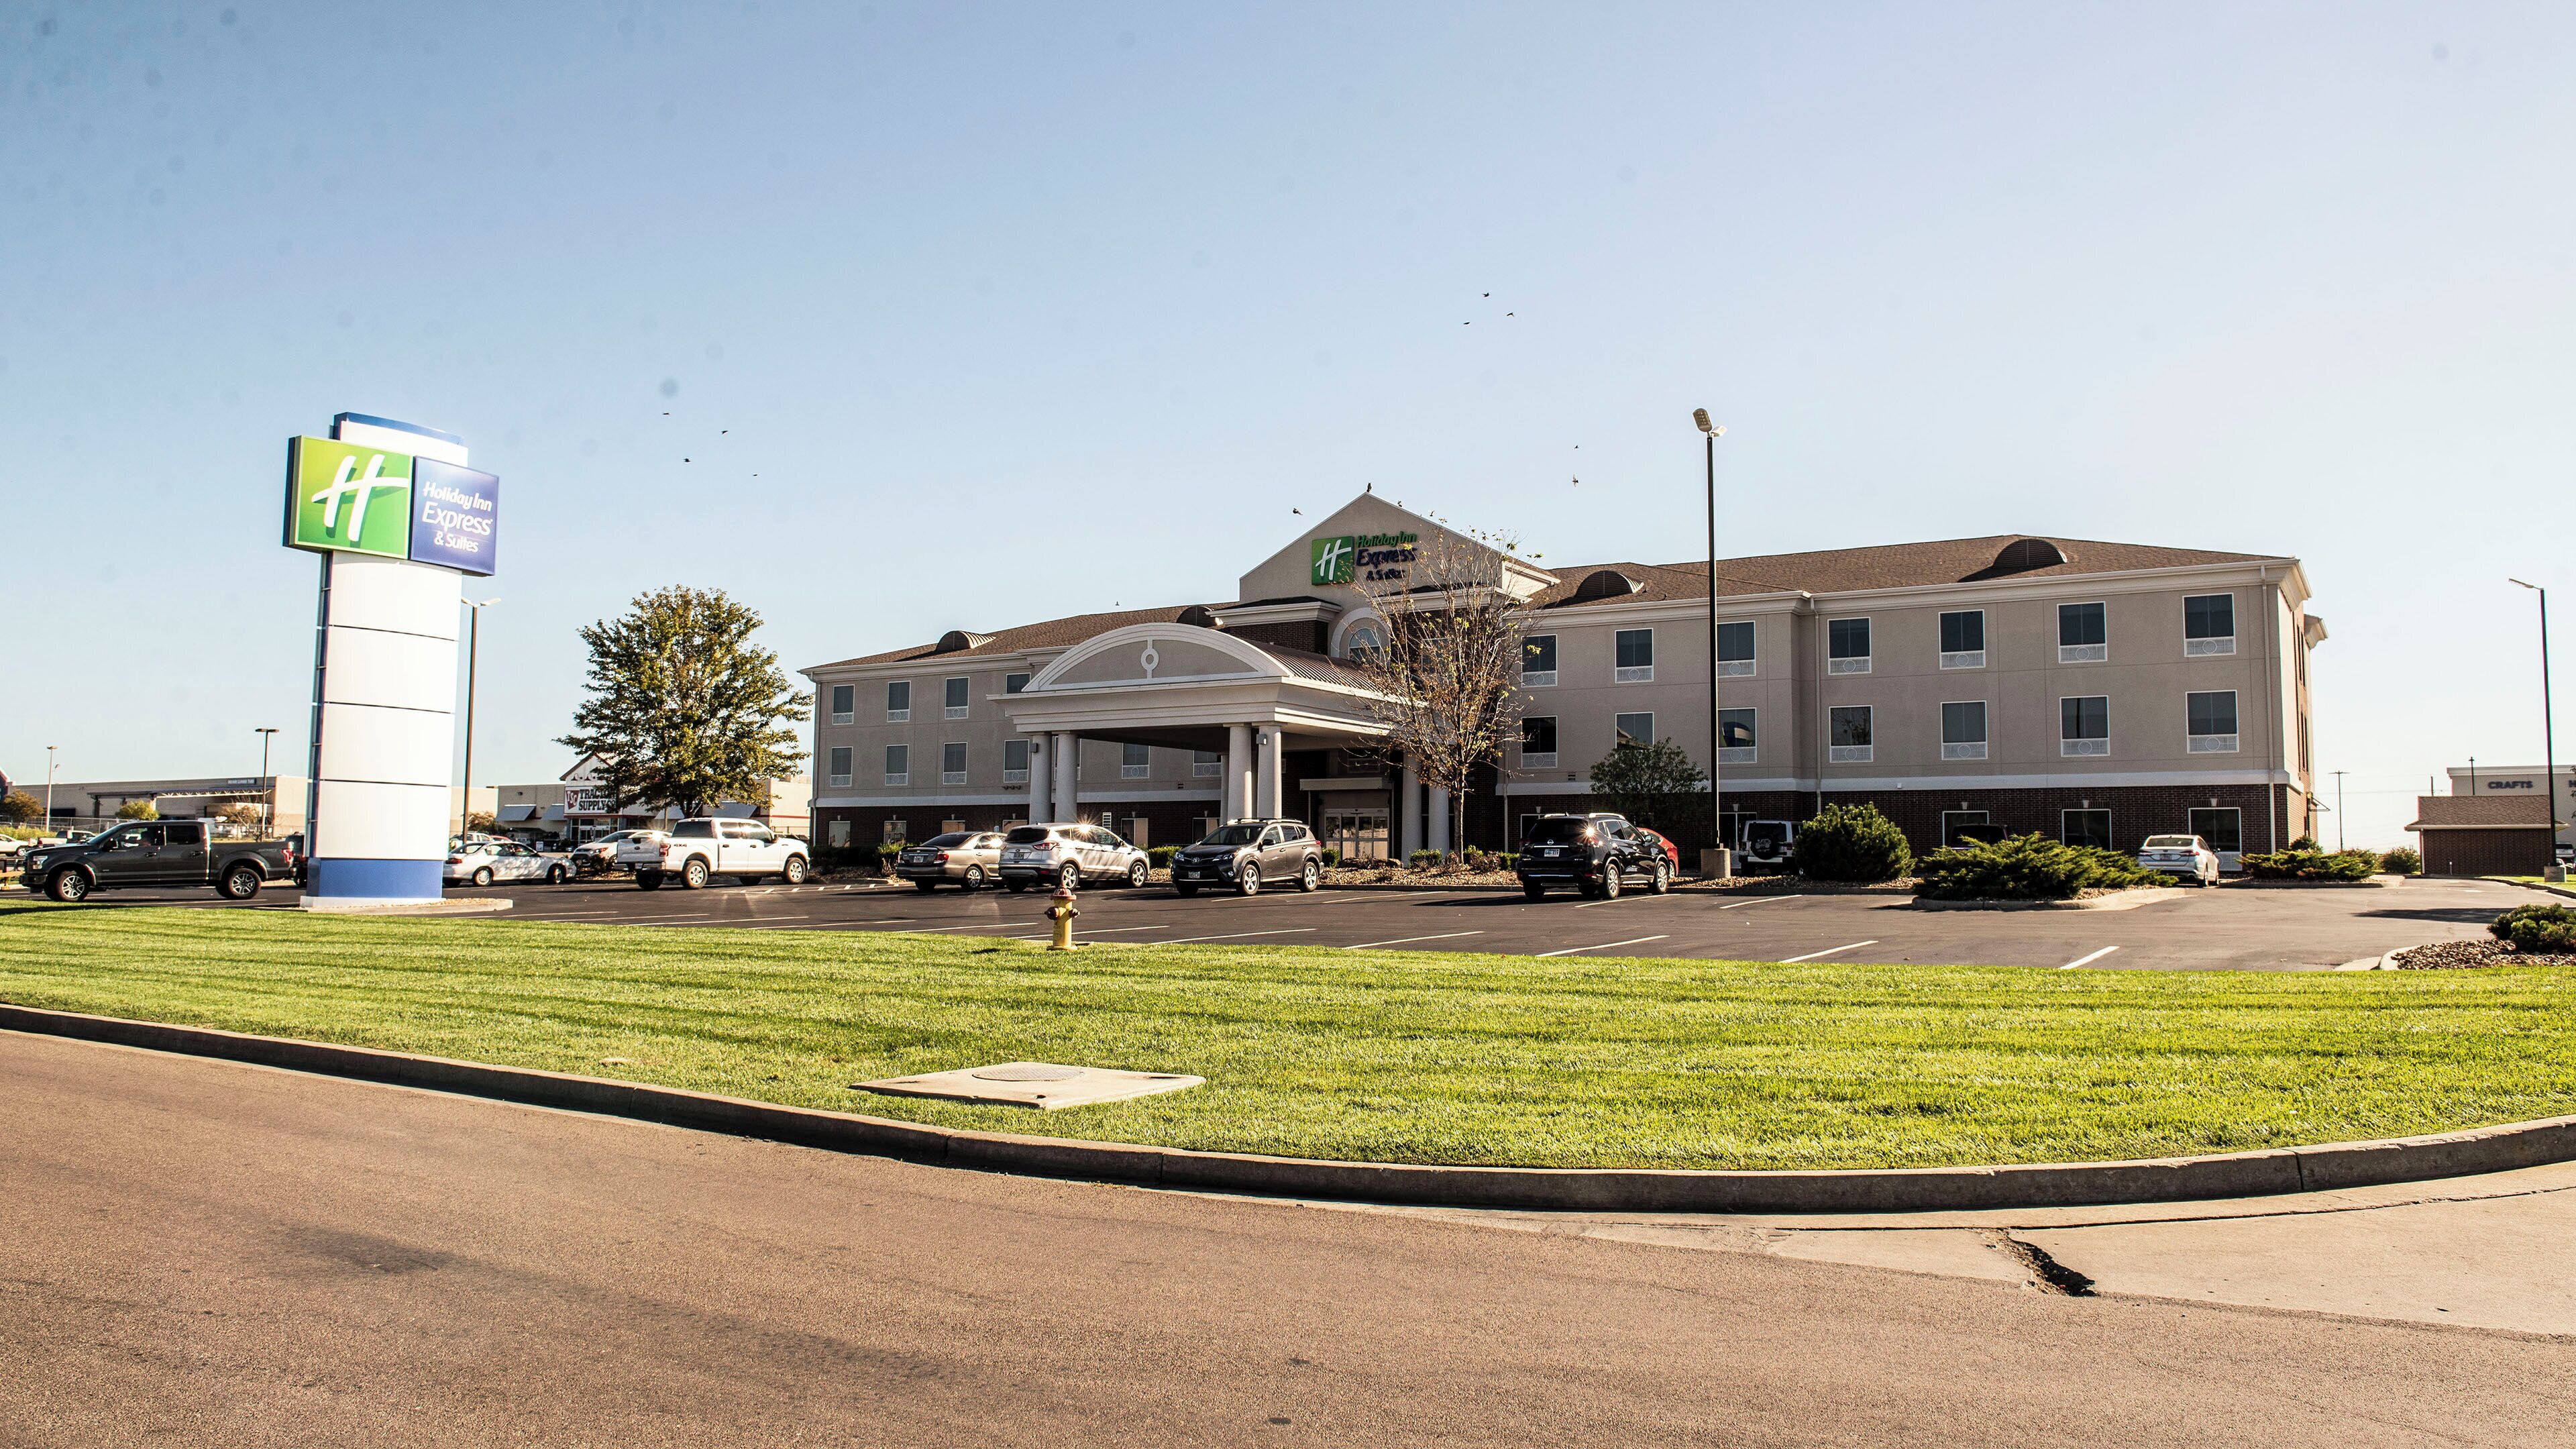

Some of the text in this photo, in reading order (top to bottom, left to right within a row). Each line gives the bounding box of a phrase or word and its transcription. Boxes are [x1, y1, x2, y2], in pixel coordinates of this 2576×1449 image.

[423, 481, 492, 512] Holiday Inn
[421, 500, 493, 536] Express
[434, 530, 479, 553] & Suites
[1356, 531, 1417, 548] Holiday Inn
[1356, 547, 1417, 569] Express
[2487, 780, 2533, 789] CRAFTS
[567, 791, 577, 806] TSC
[578, 800, 606, 810] SUPPLY
